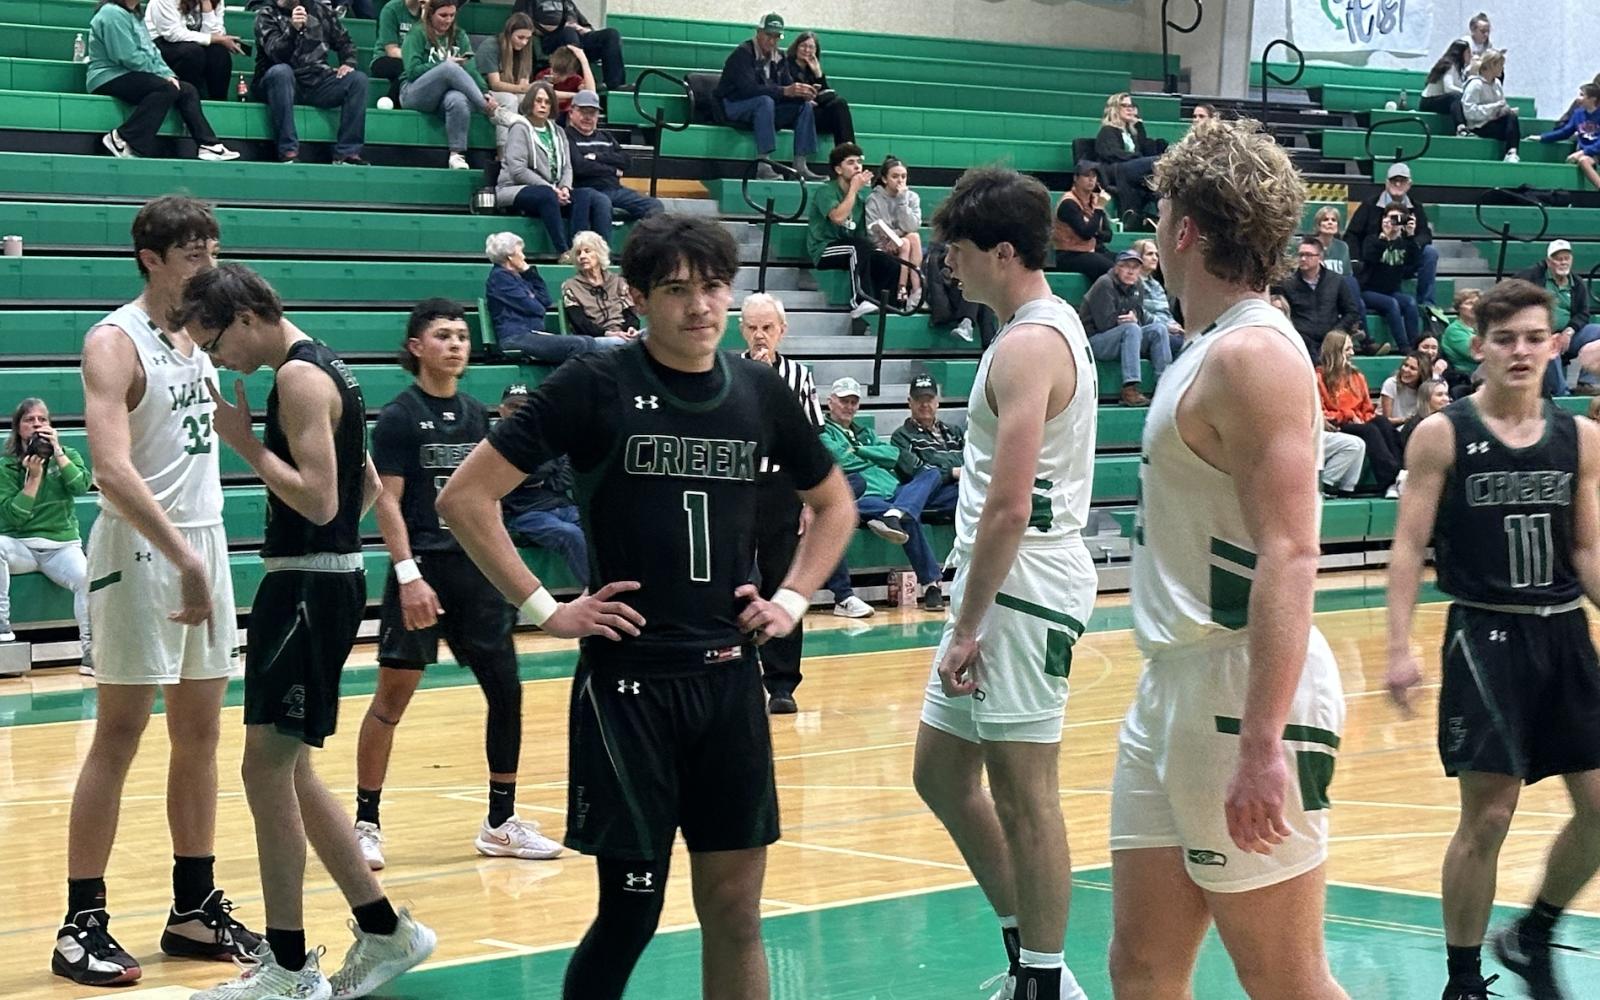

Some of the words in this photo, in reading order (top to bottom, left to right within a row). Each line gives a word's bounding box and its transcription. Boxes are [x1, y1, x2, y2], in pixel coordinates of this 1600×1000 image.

[182, 412, 212, 455] 32
[420, 442, 478, 469] CREE
[624, 434, 758, 482] CREEK
[1465, 470, 1574, 508] CREEK
[683, 490, 711, 582] 1
[1503, 512, 1554, 589] 11
